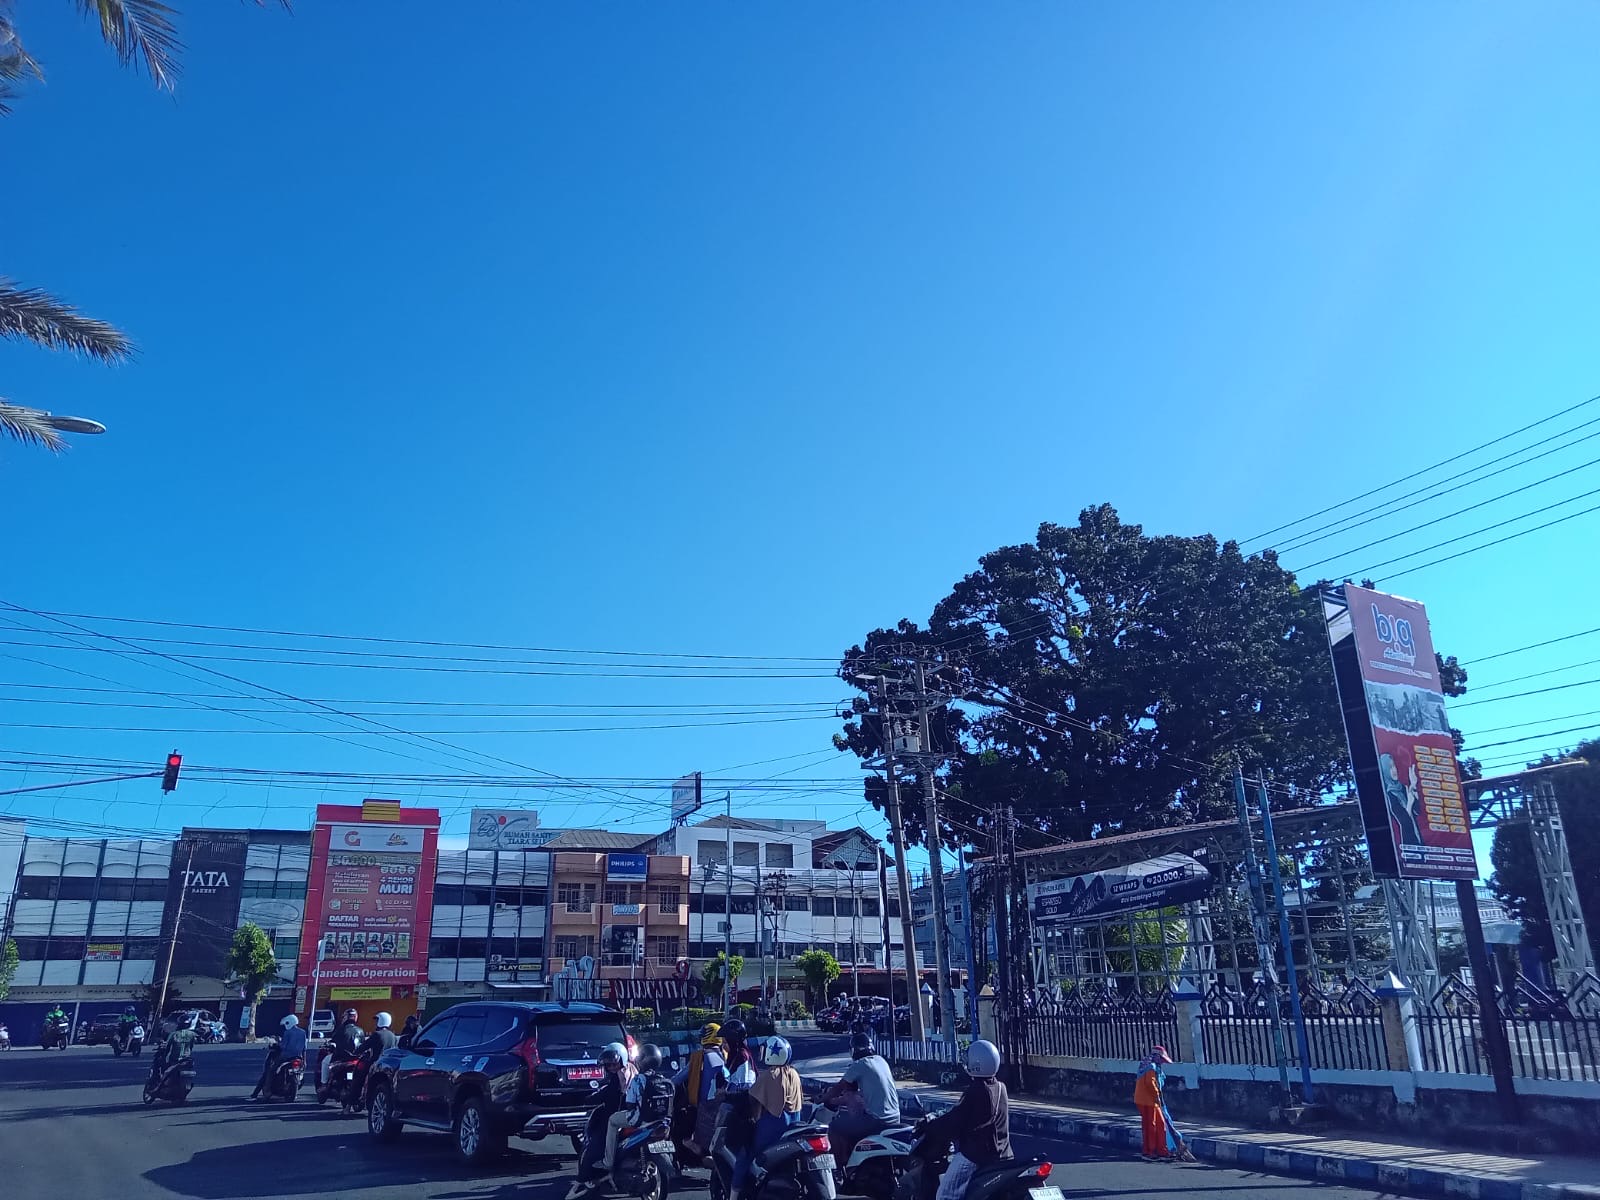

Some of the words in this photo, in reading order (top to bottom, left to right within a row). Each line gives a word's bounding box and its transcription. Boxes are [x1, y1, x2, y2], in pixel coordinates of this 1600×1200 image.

[181, 870, 230, 887] TATA
[379, 883, 413, 894] MURI
[328, 915, 359, 923] DAFTAR
[312, 968, 359, 978] Ganesha
[361, 967, 416, 979] Operation
